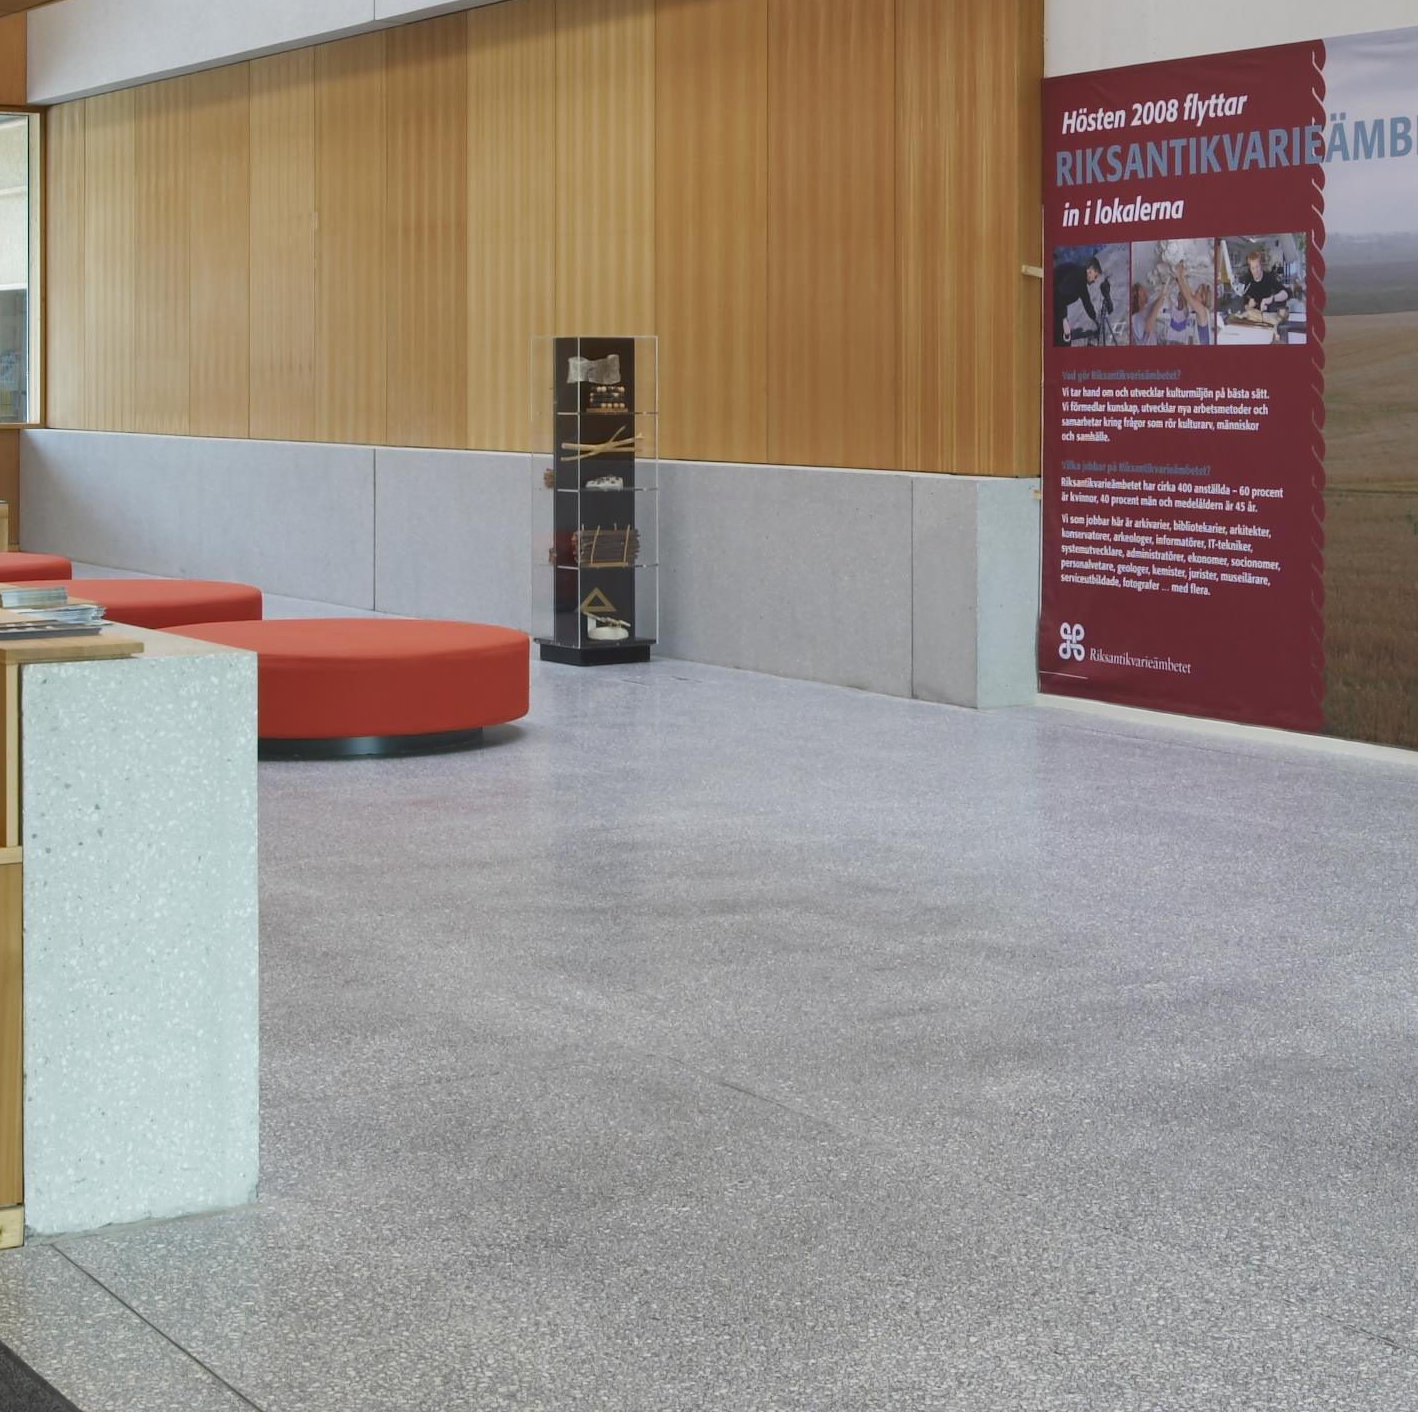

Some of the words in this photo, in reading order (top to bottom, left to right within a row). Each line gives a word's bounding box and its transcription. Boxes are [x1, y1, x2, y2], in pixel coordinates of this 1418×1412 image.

[1062, 105, 1126, 134] Hösten
[1131, 98, 1178, 126] 2008
[1183, 92, 1247, 121] flyttar
[1062, 202, 1080, 227] in
[1083, 202, 1091, 225] i
[1095, 195, 1184, 224] lokalerna
[1062, 388, 1069, 396] Vi
[1070, 388, 1081, 397] tar
[1083, 387, 1100, 397] hand
[1102, 389, 1113, 397] om
[1115, 387, 1128, 397] och
[1130, 387, 1164, 397] utvecklar
[1215, 387, 1225, 401] på
[1227, 387, 1249, 399] bästa
[1251, 388, 1269, 399] sätt.
[1062, 402, 1069, 411] Vi
[1070, 401, 1105, 412] förmedlar
[1107, 402, 1139, 415] kunskap,
[1141, 402, 1176, 412] utvecklar
[1178, 405, 1191, 416] nya
[1193, 403, 1251, 414] arbetsmetoder
[1253, 404, 1268, 414] och
[1062, 416, 1102, 426] samarbetar
[1104, 416, 1121, 430] kring
[1124, 417, 1145, 430] frågor
[1147, 420, 1163, 428] som
[1165, 418, 1176, 428] rör
[1178, 418, 1215, 430] kulturarv,
[1217, 420, 1259, 430] människor
[1062, 431, 1074, 440] och
[1143, 480, 1155, 490] har
[1157, 481, 1176, 492] cirka
[1178, 483, 1192, 493] 400
[1194, 484, 1230, 495] anställda
[1239, 486, 1249, 496] 60
[1252, 488, 1283, 499] procent
[1062, 492, 1069, 501] är
[1070, 492, 1098, 504] kvinnor,
[1100, 494, 1109, 503] 40
[1111, 496, 1139, 507] procent
[1141, 496, 1157, 506] män
[1159, 497, 1173, 507] och
[1175, 497, 1223, 510] medelåldern
[1225, 501, 1233, 511] är
[1235, 502, 1245, 511] 45
[1247, 501, 1258, 513] år.
[1062, 514, 1068, 523] Vi
[1070, 516, 1084, 524] som
[1086, 515, 1109, 527] jobbar
[1111, 516, 1124, 526] här
[1125, 517, 1133, 526] är
[1173, 520, 1227, 535] bibliotekarier,
[1230, 524, 1271, 538] arkitekter,
[1156, 535, 1206, 549] informatörer,
[1208, 539, 1253, 553] IT-tekniker,
[1188, 552, 1229, 567] ekonomer,
[1231, 557, 1281, 571] socionomer,
[1152, 564, 1187, 579] kemister,
[1188, 568, 1218, 582] jurister,
[1221, 572, 1270, 586] museilärare,
[1123, 577, 1159, 592] fotografer
[1171, 583, 1188, 593] med
[1190, 583, 1211, 595] flera.
[1089, 648, 1192, 674] Riksantikvarieämbetet
